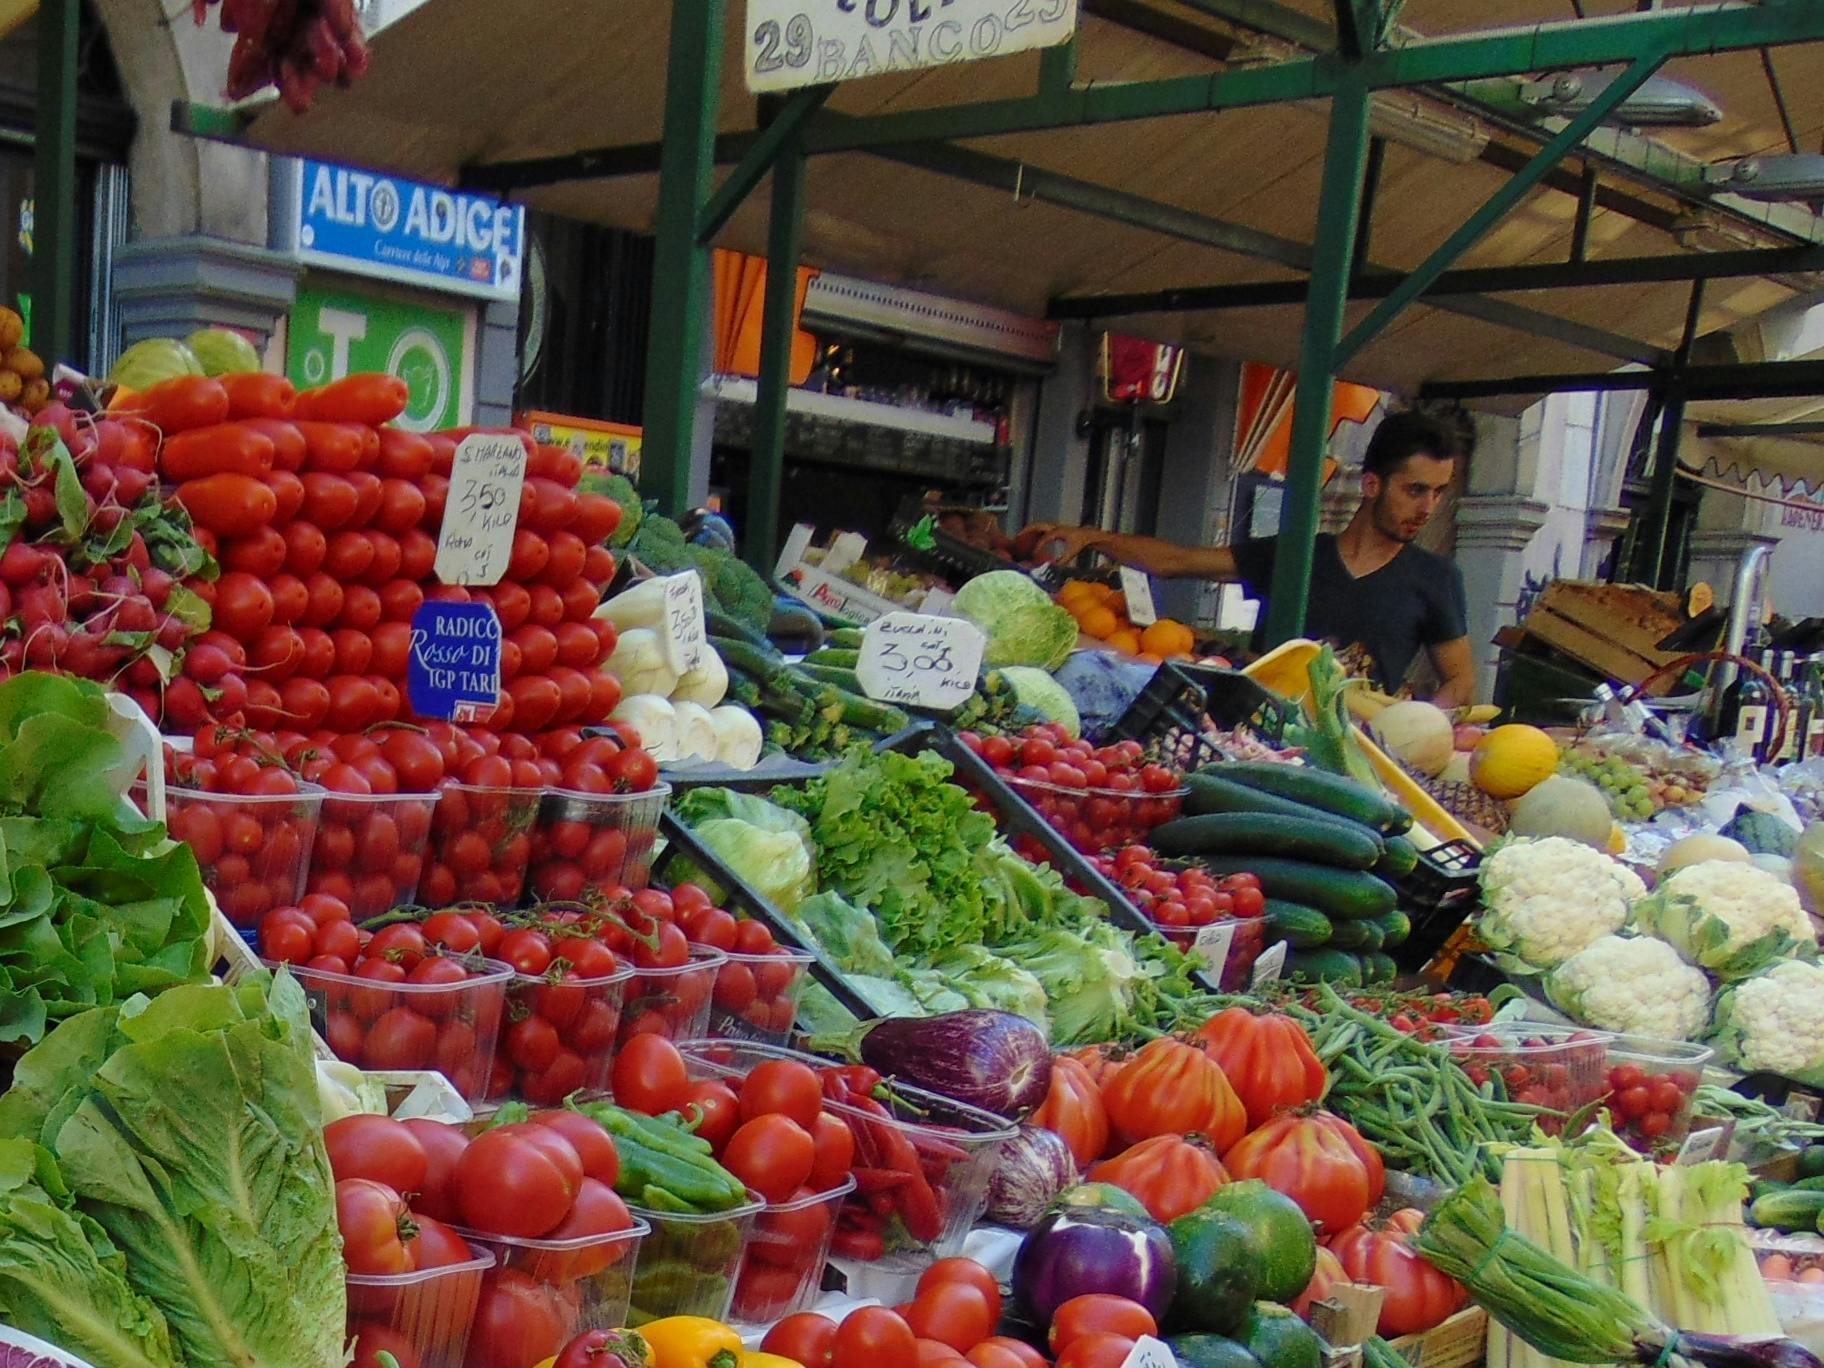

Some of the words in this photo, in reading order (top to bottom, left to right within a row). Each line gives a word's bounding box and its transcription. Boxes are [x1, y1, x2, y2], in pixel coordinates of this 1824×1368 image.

[753, 12, 814, 74] 29
[814, 14, 1003, 82] BANCO
[308, 163, 400, 234] ALTO
[404, 186, 513, 254] ADIGE
[460, 479, 507, 522] 3,50
[471, 645, 491, 666] DI
